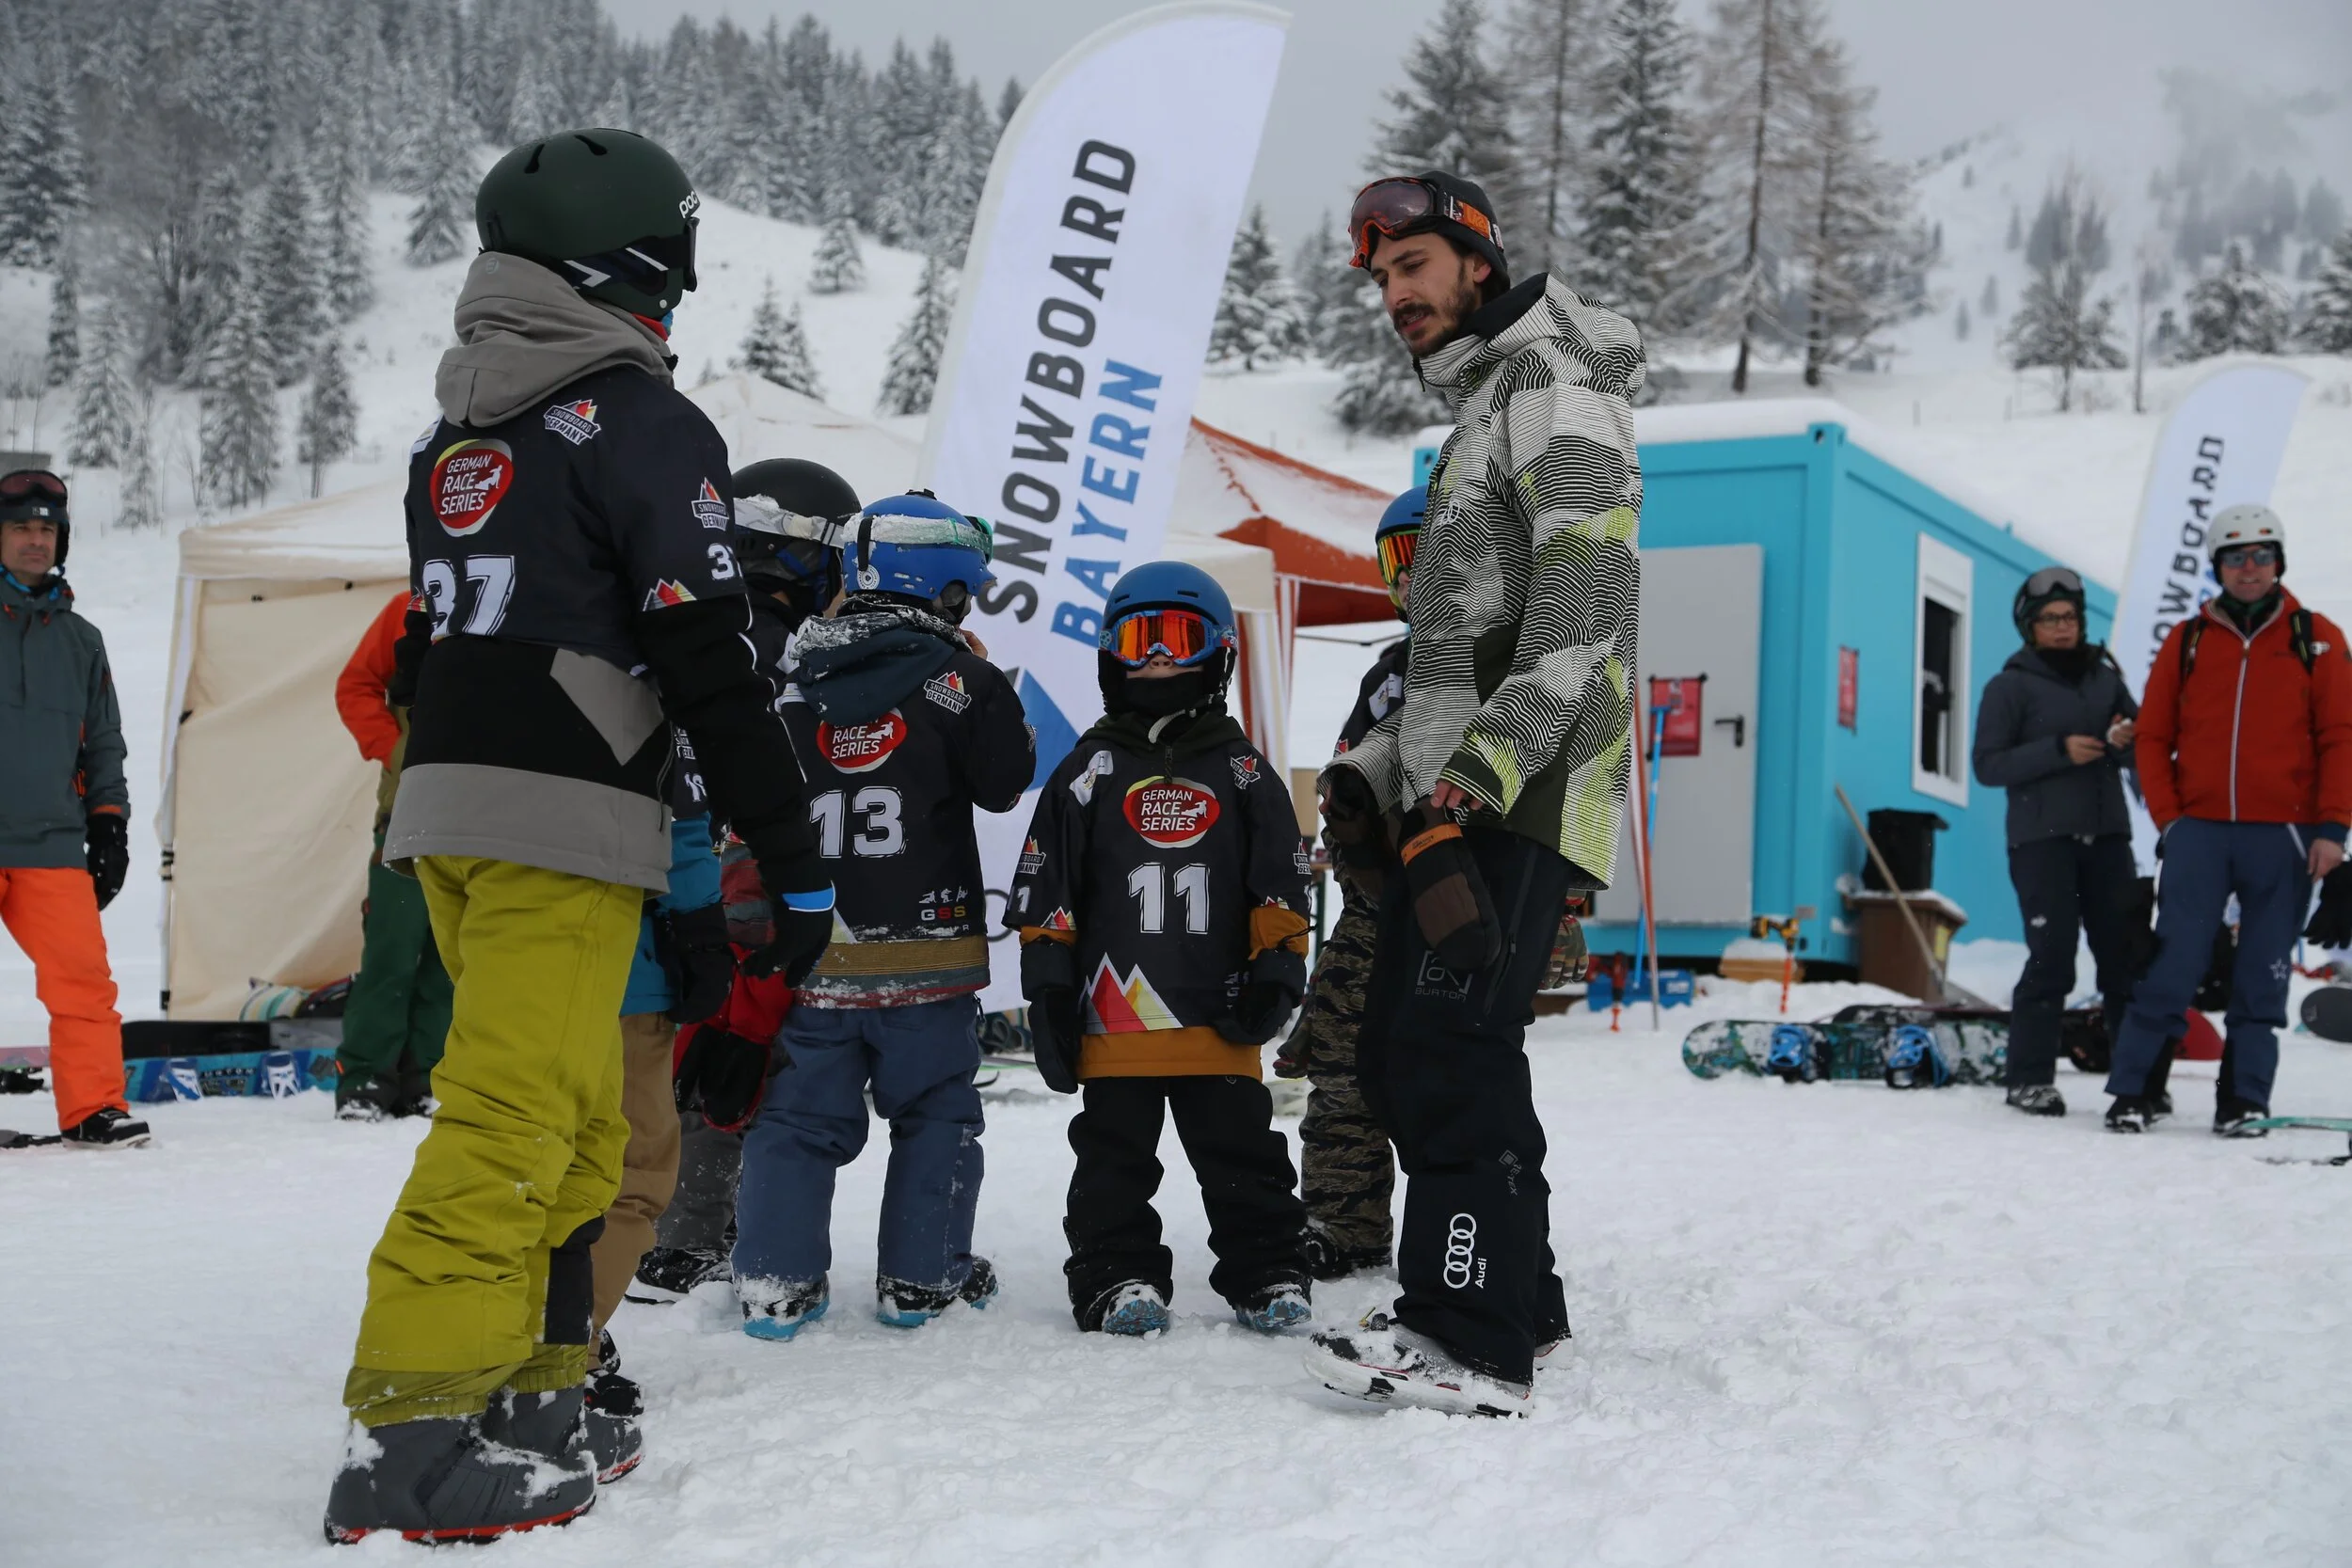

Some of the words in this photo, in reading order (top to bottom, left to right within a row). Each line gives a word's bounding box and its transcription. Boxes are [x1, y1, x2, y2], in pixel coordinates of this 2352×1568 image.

[977, 138, 1137, 626] SNOWBOARD
[546, 417, 586, 443] GERMANY
[551, 408, 593, 433] SNOWBOARD
[446, 454, 492, 473] GERMAN
[442, 473, 475, 494] RACE
[439, 491, 486, 515] SERIES
[1050, 358, 1164, 649] BAYERN
[707, 543, 743, 580] 3
[2149, 435, 2224, 670] OWBOARD
[422, 555, 516, 637] 37
[928, 690, 963, 713] GERMANY
[930, 682, 966, 704] SNOWBOARD
[832, 725, 868, 744] RACE
[832, 740, 881, 759] SERIES
[1141, 789, 1193, 801] GERMAN
[1140, 801, 1183, 816] RACE
[809, 786, 909, 858] 13
[1140, 817, 1196, 832] SERIES
[1128, 862, 1211, 934] 11
[921, 906, 966, 921] GSS
[1415, 987, 1467, 1003] BURTON
[1474, 1257, 1487, 1290] Audi
